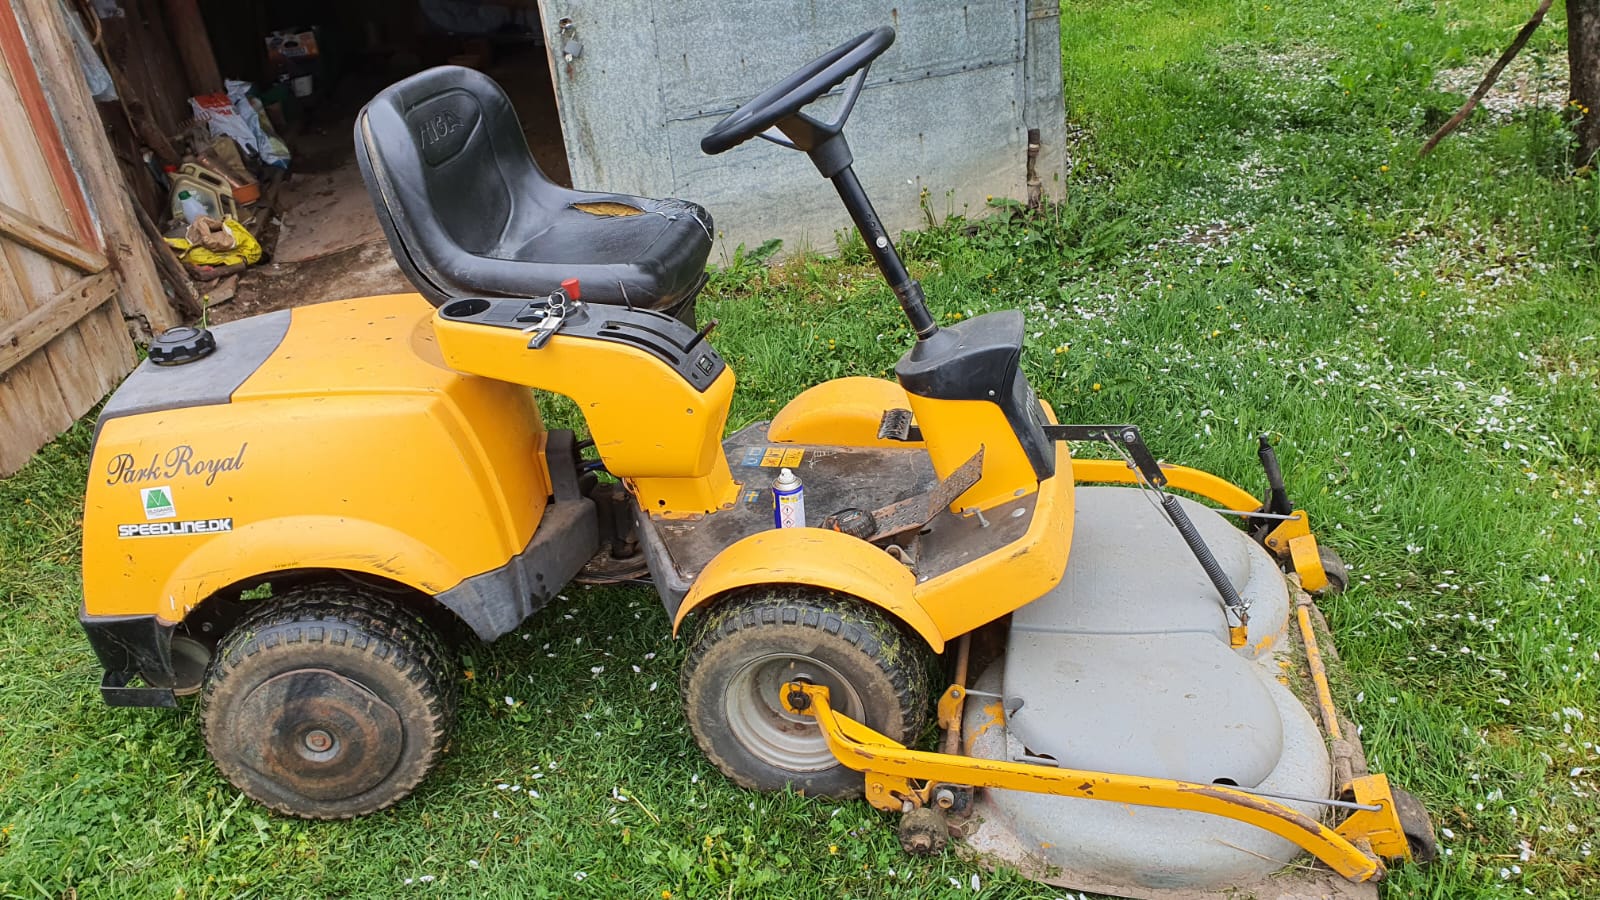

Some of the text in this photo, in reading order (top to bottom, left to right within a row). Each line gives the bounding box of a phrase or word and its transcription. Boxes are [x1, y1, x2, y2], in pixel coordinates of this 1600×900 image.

[106, 442, 248, 486] Park Royal
[118, 518, 231, 537] SPEEDLINE.DK
